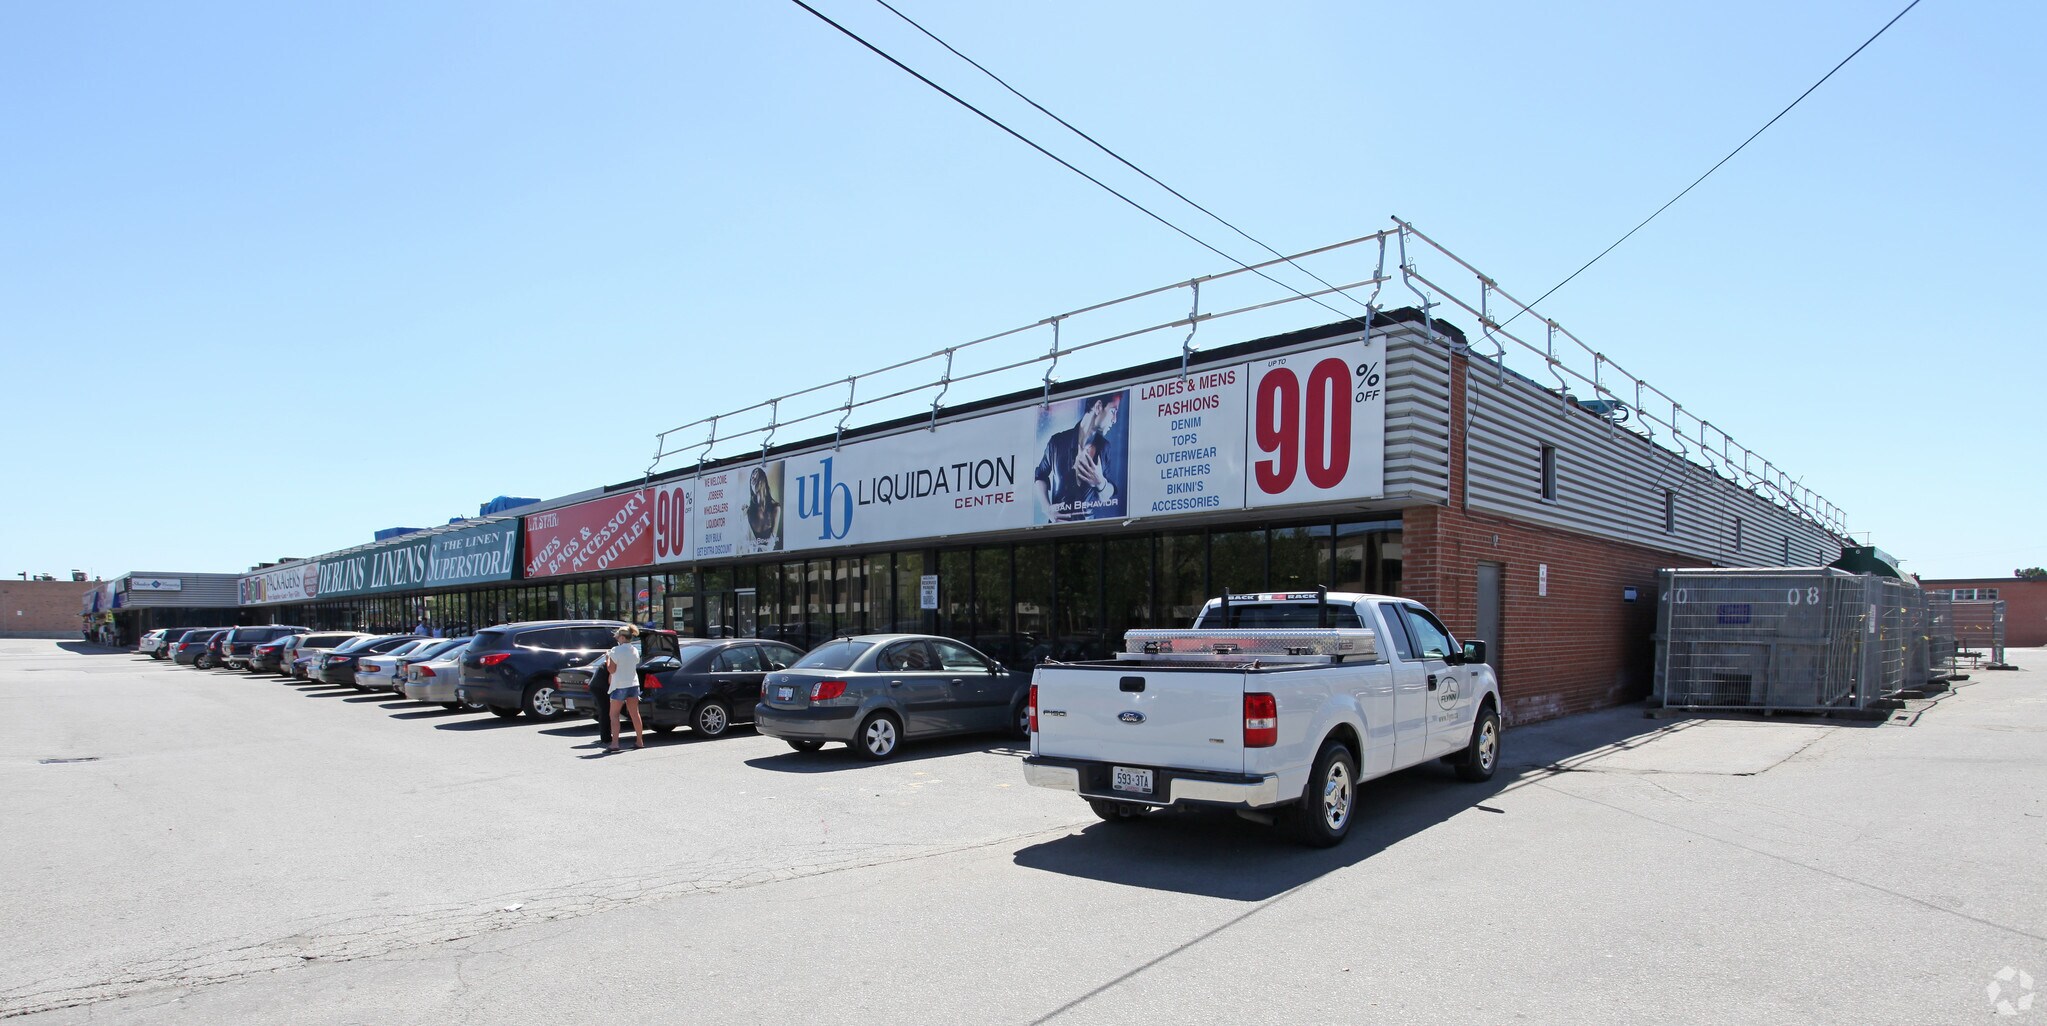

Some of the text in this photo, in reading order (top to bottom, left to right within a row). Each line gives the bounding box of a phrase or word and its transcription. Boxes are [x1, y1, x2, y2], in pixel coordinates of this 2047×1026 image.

[1268, 358, 1287, 368] UP TO
[1141, 370, 1236, 401] LADIES & MENS
[1355, 389, 1380, 403] OFF
[1157, 394, 1220, 417] FASHIONS
[1171, 416, 1202, 431] DENIM
[1255, 357, 1352, 494] 90
[1172, 433, 1197, 447] TOPS
[1155, 446, 1217, 465] OUTERWEAR
[710, 474, 728, 486] WELCOME
[1160, 463, 1211, 480] LEATHERS
[708, 489, 724, 501] JOBBERS
[1167, 481, 1204, 495] BIKINI'S
[796, 454, 1016, 540] ub LIQUIDATION
[955, 491, 1015, 509] CENTRE
[1151, 495, 1220, 512] ACCESSORIES
[703, 503, 729, 515] WHOLESALERS
[571, 486, 648, 572] ACCESSORY
[656, 487, 685, 558] 90
[706, 517, 726, 529] LIQUIDATOR
[443, 531, 500, 551] THE LINEN
[597, 511, 651, 569] OUTLET
[705, 532, 722, 543] BUY BULK
[427, 530, 515, 582] SUPERSTORE
[526, 536, 561, 577] SHOES
[548, 526, 592, 575] BAGS &
[704, 545, 715, 556] EXTRA
[715, 543, 733, 555] DISCOUNT
[317, 555, 366, 595] DEBLINS
[370, 543, 428, 589] LINENS
[266, 568, 300, 591] PACKAGERS
[1441, 693, 1457, 703] FLYNN
[1121, 712, 1138, 722] Ford
